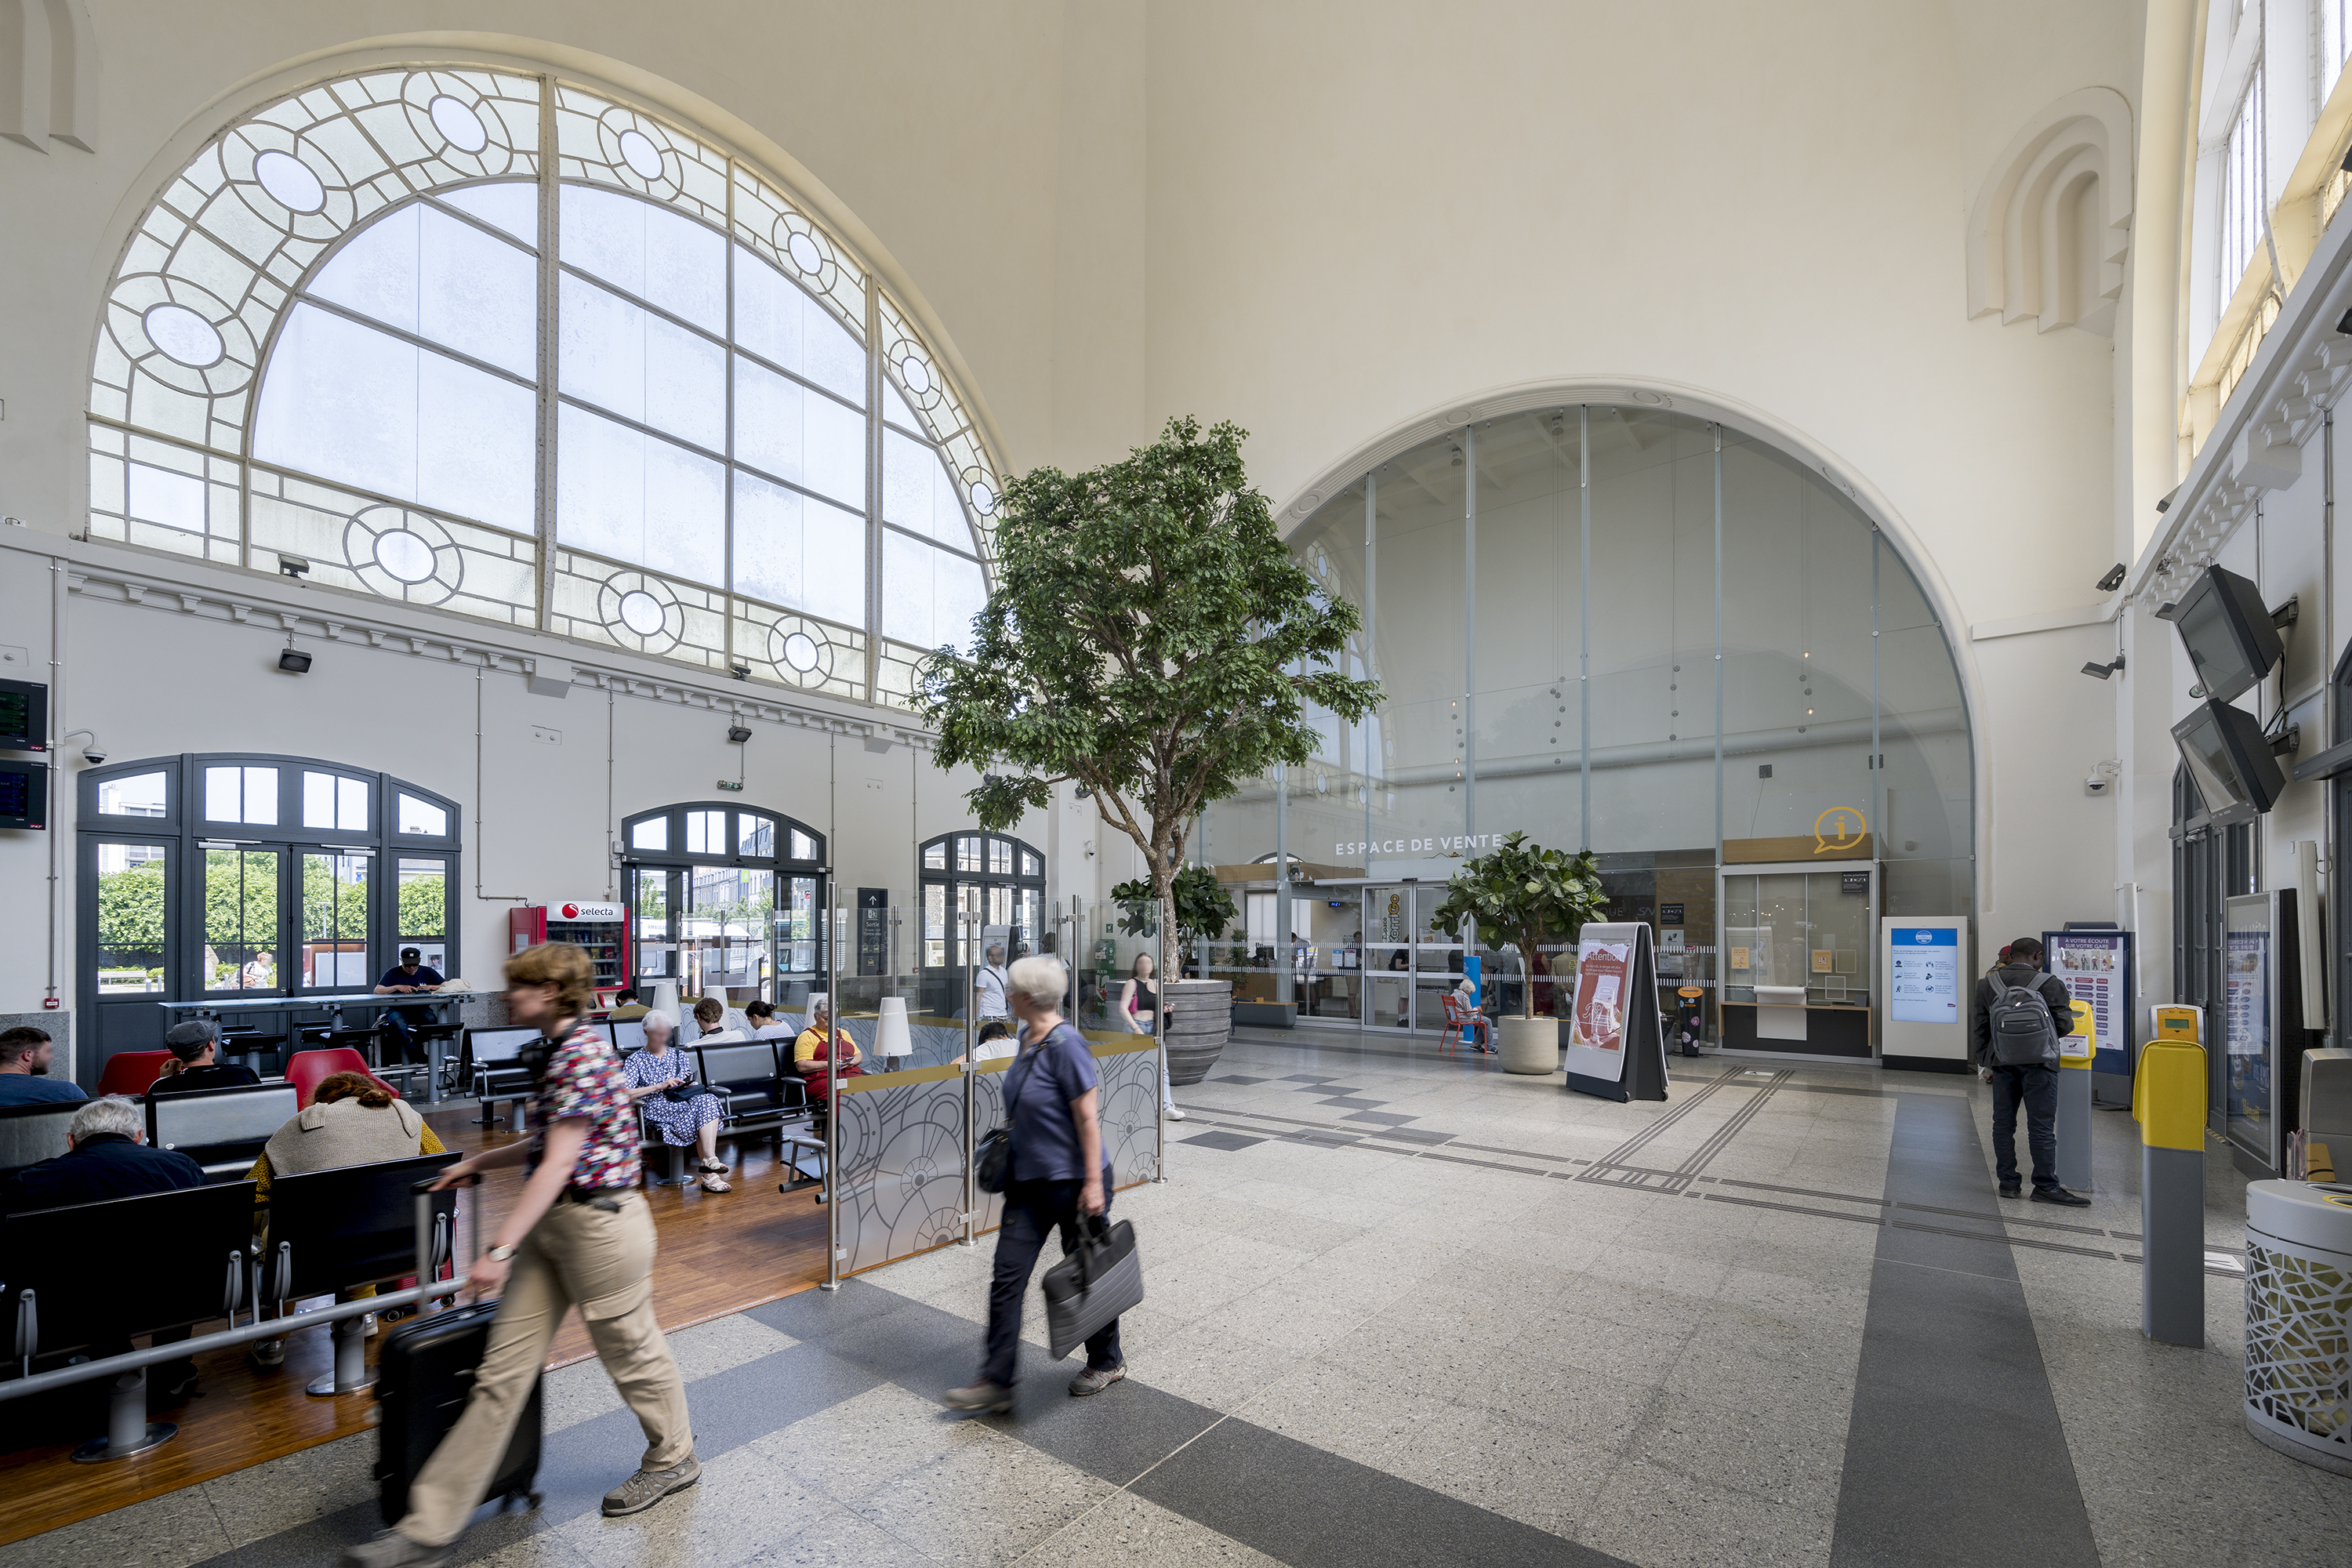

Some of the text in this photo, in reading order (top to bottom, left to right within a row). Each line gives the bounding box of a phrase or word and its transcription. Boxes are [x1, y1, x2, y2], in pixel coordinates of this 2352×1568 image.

[1336, 834, 1502, 855] ESPACE DE VENTE
[1586, 952, 1621, 961] Attention
[663, 1322, 690, 1332] voyageurs
[738, 1299, 760, 1308] transport
[569, 1353, 591, 1362] espace
